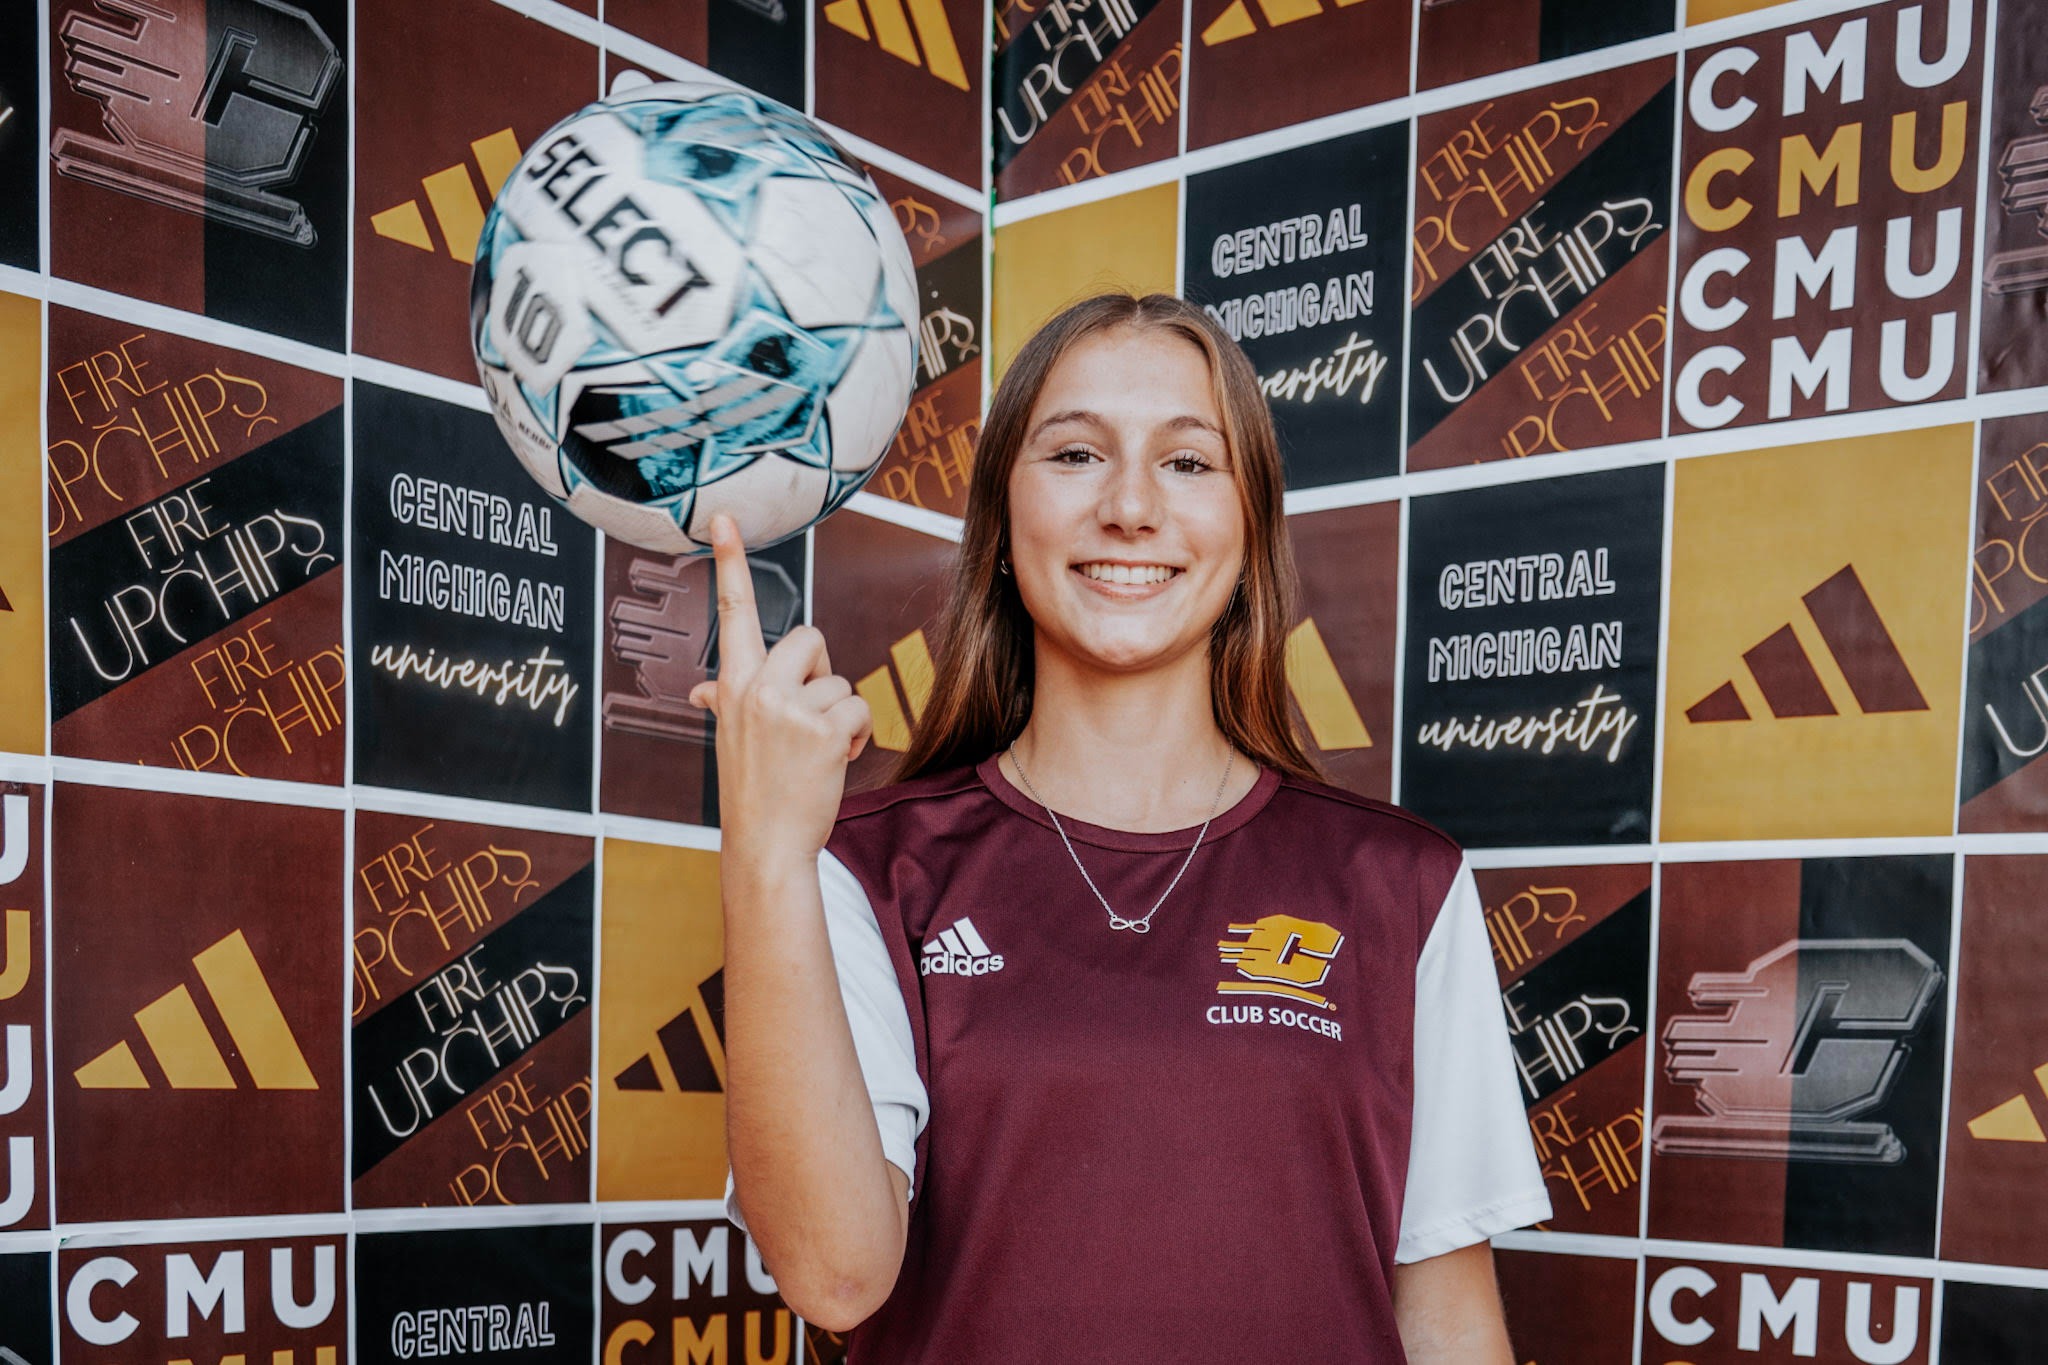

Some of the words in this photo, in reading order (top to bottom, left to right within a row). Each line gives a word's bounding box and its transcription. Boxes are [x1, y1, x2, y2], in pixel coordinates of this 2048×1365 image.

[1072, 44, 1147, 135] FIRE
[1689, 0, 1972, 132] CMU
[1420, 103, 1512, 200] FIRE
[1685, 101, 1967, 232] CMU
[527, 135, 713, 318] SELECT
[1211, 203, 1369, 279] CENTRAL
[1469, 200, 1563, 299] FIRE
[1680, 207, 1962, 331] CMU
[504, 267, 564, 365] 10
[1520, 302, 1616, 401] FIRE
[57, 333, 168, 425] FIRE
[1675, 312, 1957, 429] CMU
[126, 478, 230, 569] FIRE
[390, 473, 559, 557] CENTRAL
[379, 549, 565, 633] MICHIGAN
[1438, 548, 1616, 611] CENTRAL
[191, 617, 294, 710] FIRE
[371, 644, 579, 728] university
[1428, 621, 1623, 683] MICHIGAN
[1418, 684, 1638, 763] university
[360, 823, 452, 913] FIRE
[415, 944, 502, 1034] FIRE
[920, 950, 1005, 977] adidas
[1206, 1005, 1264, 1025] CLUB
[1268, 1007, 1342, 1042] SOCCER
[466, 1060, 552, 1150] FIRE
[67, 1245, 336, 1346] CMU
[391, 1302, 556, 1361] CENTRAL
[1649, 1266, 1920, 1365] CMU
